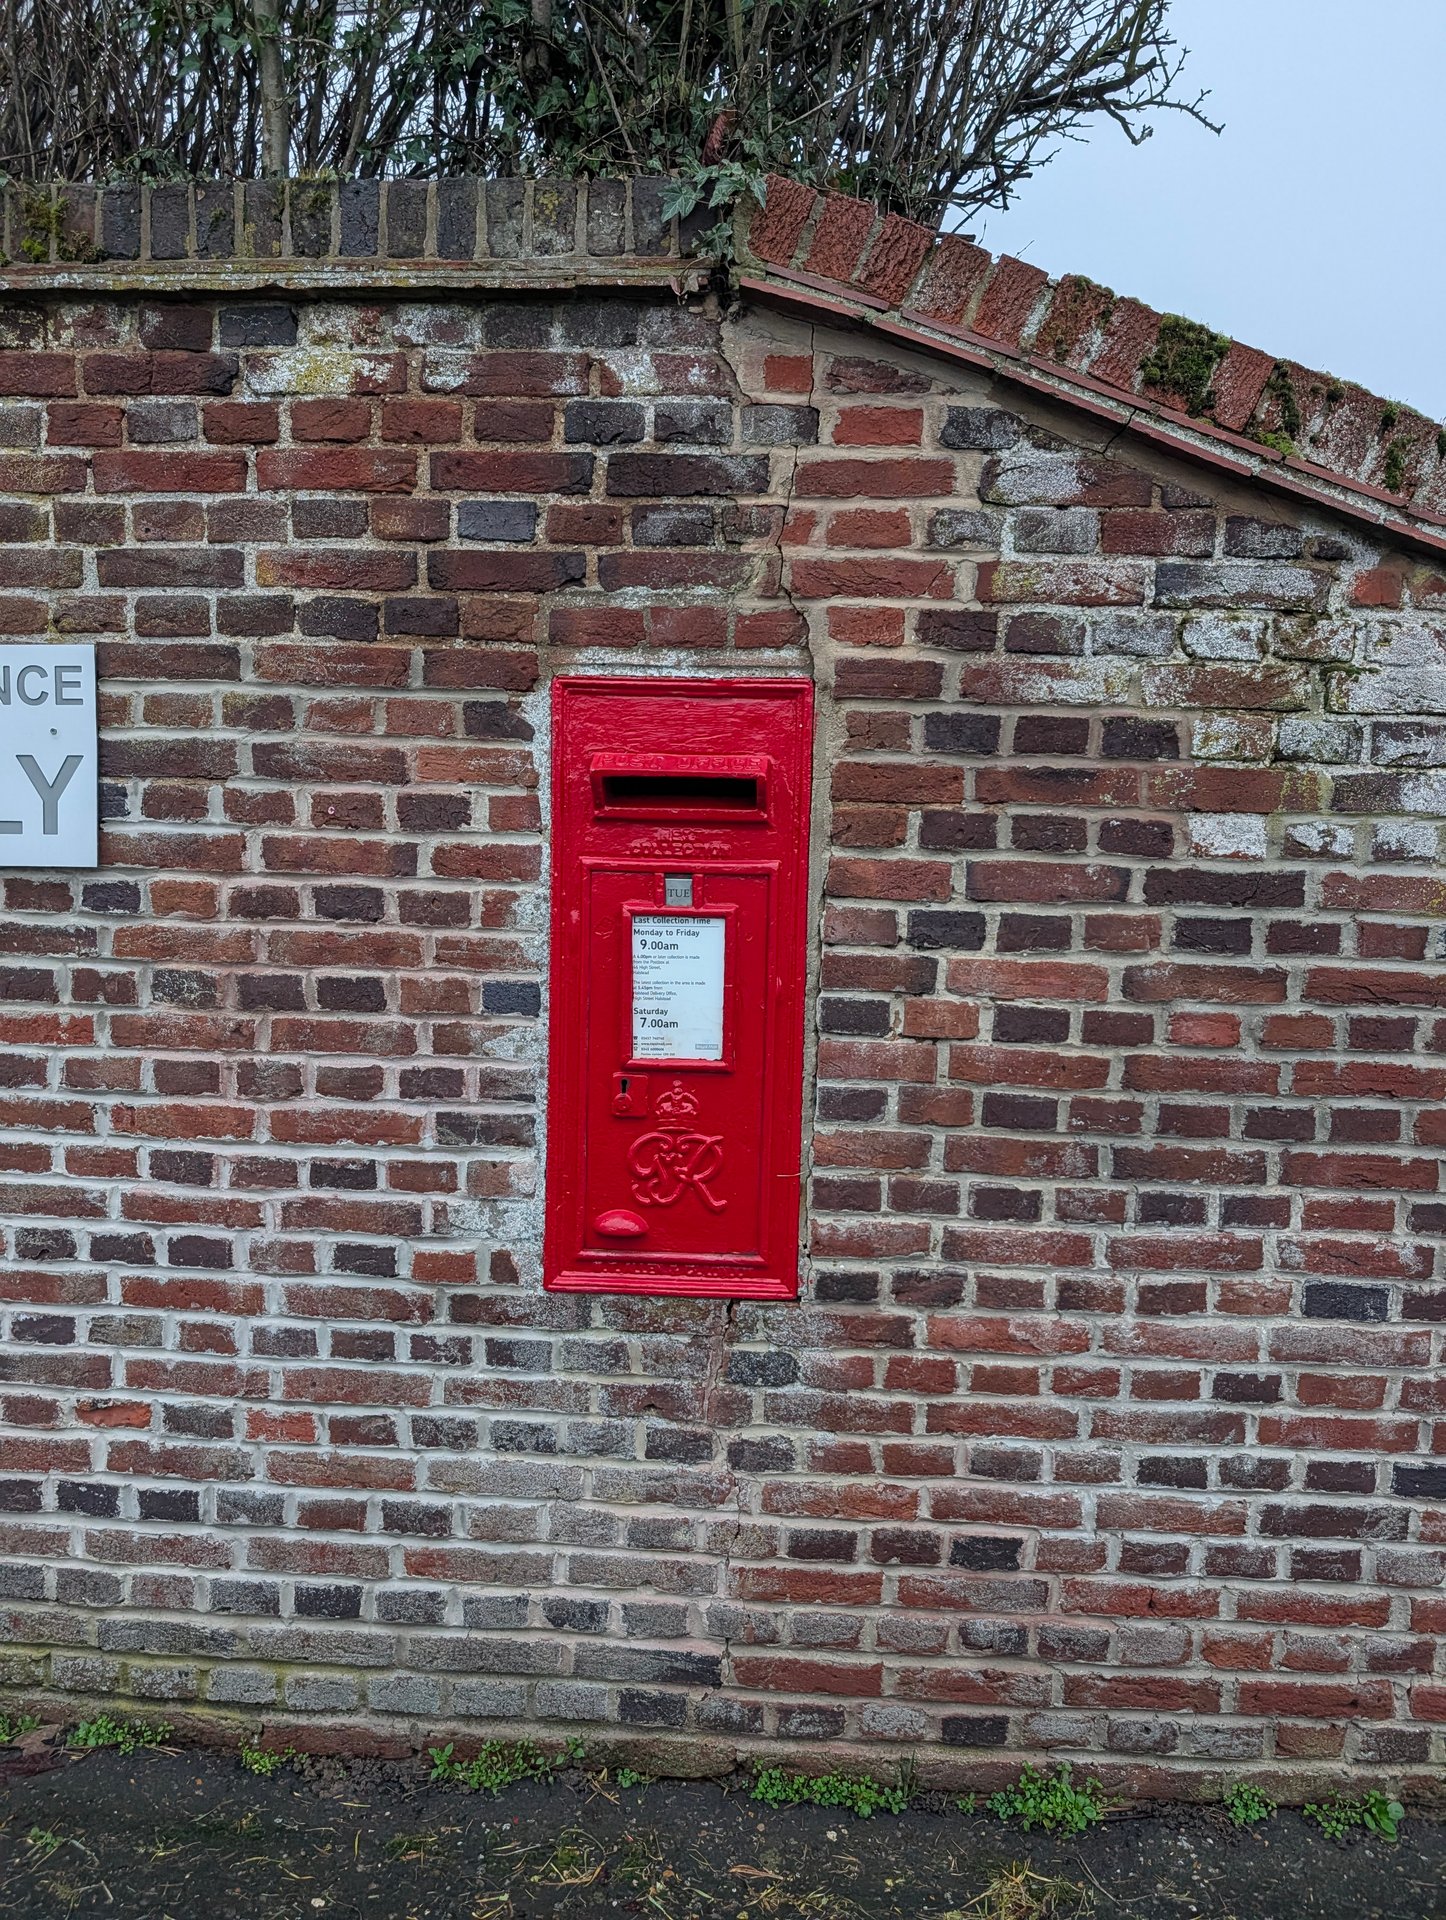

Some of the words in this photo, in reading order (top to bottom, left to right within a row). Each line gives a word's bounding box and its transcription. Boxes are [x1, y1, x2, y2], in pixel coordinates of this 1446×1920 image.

[599, 755, 664, 769] POST
[677, 757, 761, 771] OFFICE
[0, 754, 84, 835] Y
[667, 888, 690, 898] TUE
[633, 916, 650, 924] Last
[652, 916, 690, 924] Collection
[692, 917, 711, 925] Time
[633, 929, 663, 937] Monday
[676, 929, 700, 938] Friday
[640, 939, 679, 950] 9.00am
[634, 1007, 668, 1016] Saturday
[640, 1017, 678, 1028] 7.00am
